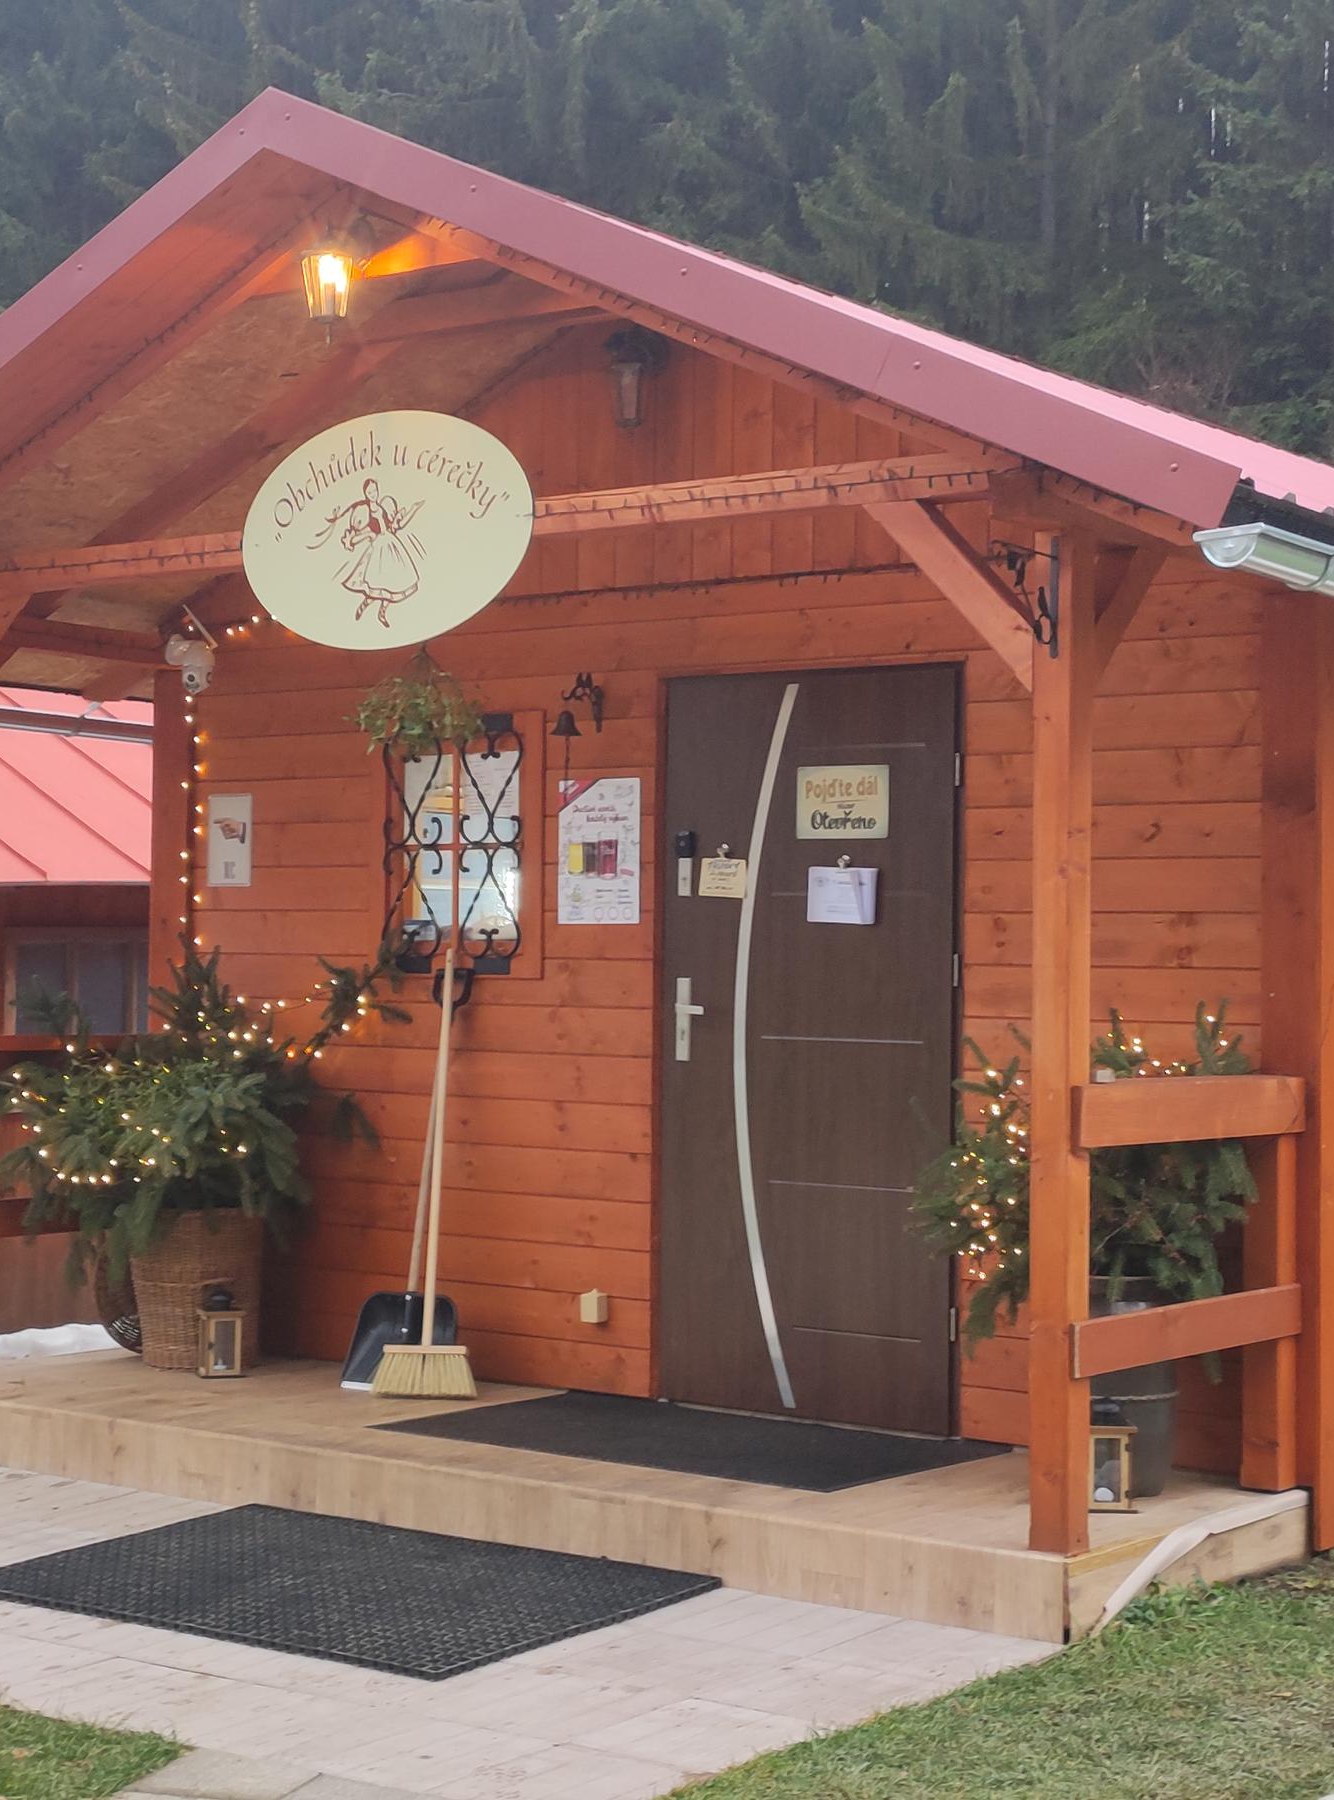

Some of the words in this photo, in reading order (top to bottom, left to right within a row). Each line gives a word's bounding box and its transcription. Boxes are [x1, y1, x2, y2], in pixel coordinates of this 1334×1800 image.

[393, 444, 407, 467] u
[805, 777, 852, 801] Pojďte
[810, 808, 877, 830] Otevřeno
